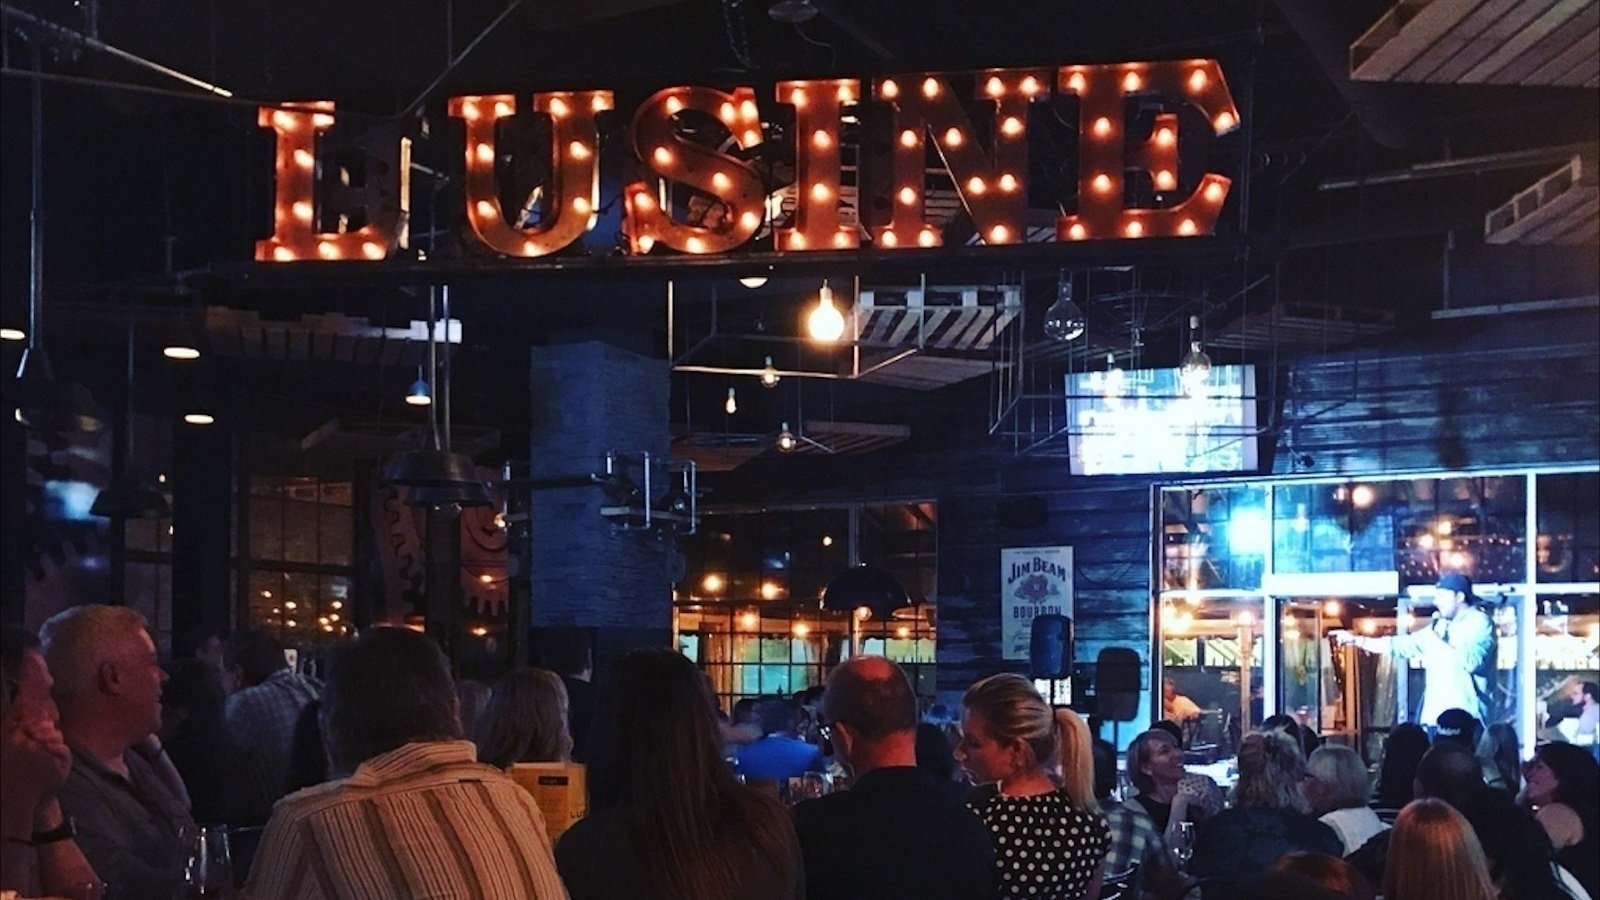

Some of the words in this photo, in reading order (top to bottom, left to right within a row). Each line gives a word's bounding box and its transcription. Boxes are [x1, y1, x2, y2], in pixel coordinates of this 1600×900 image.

[255, 58, 1241, 261] LUSINE
[1008, 562, 1030, 584] JIM
[1033, 557, 1066, 582] BEAM
